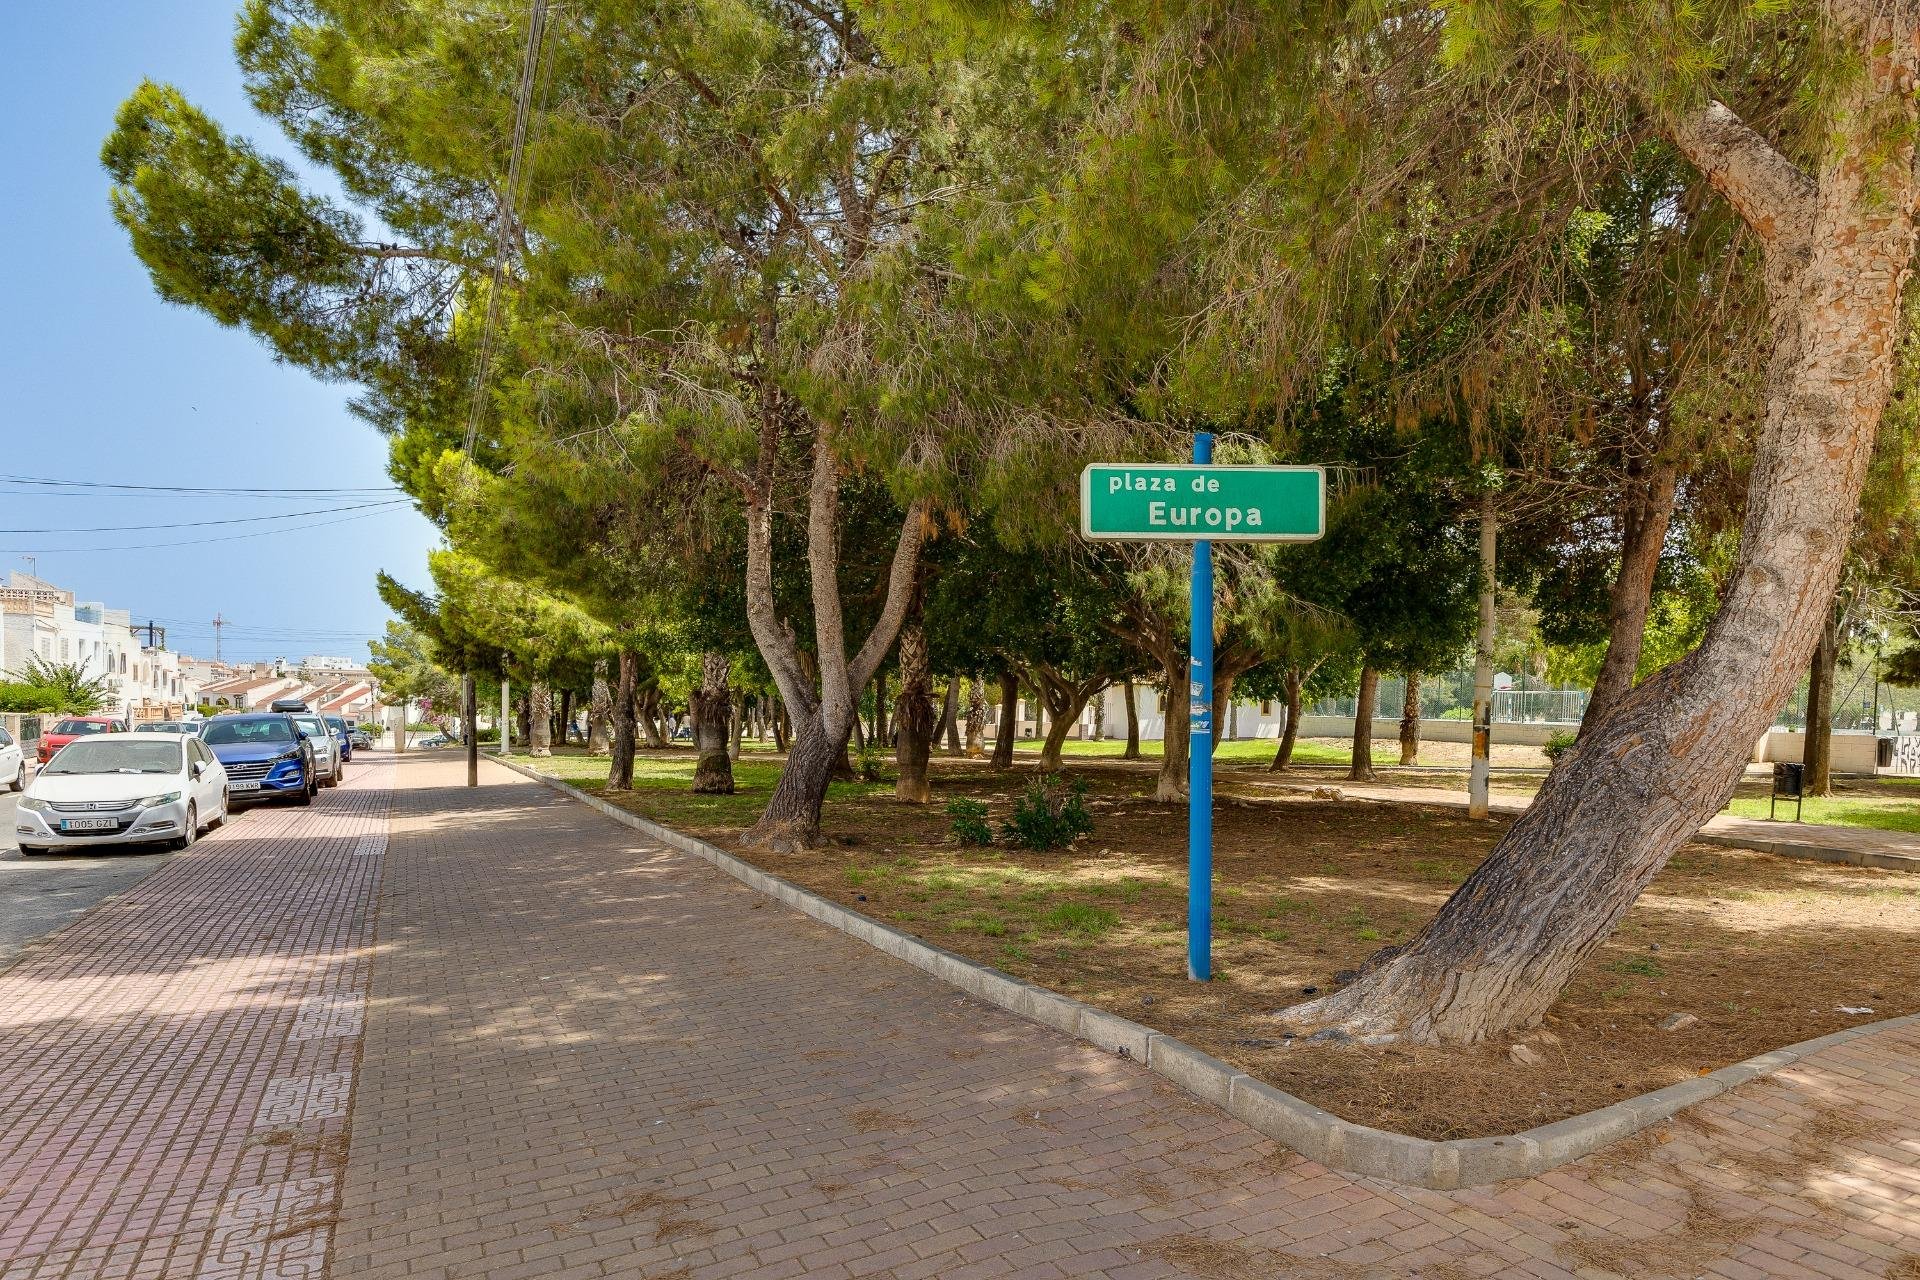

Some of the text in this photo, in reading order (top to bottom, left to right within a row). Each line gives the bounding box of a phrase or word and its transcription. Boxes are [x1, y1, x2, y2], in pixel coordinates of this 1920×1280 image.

[1109, 472, 1220, 494] plaza de
[1149, 501, 1262, 531] Europa
[69, 820, 94, 829] 1005
